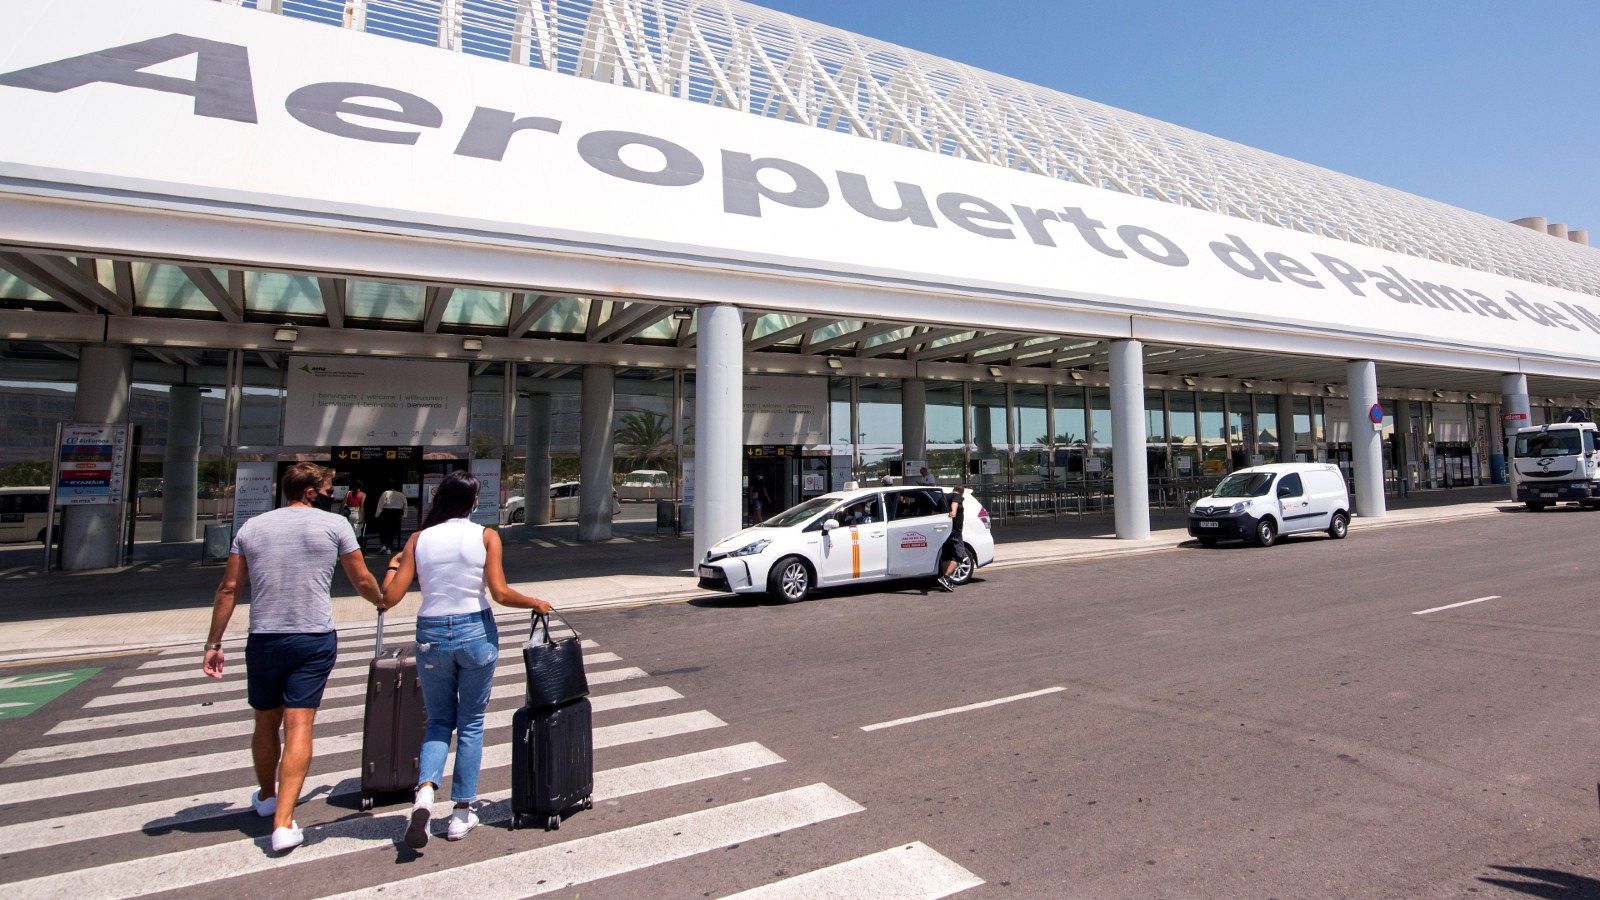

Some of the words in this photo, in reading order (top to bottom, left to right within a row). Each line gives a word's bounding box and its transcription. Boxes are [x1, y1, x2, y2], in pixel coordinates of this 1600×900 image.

[0, 33, 1190, 268] Aeropuerto
[1208, 233, 1326, 290] de
[1310, 251, 1518, 322] Palma
[1505, 290, 1580, 332] de
